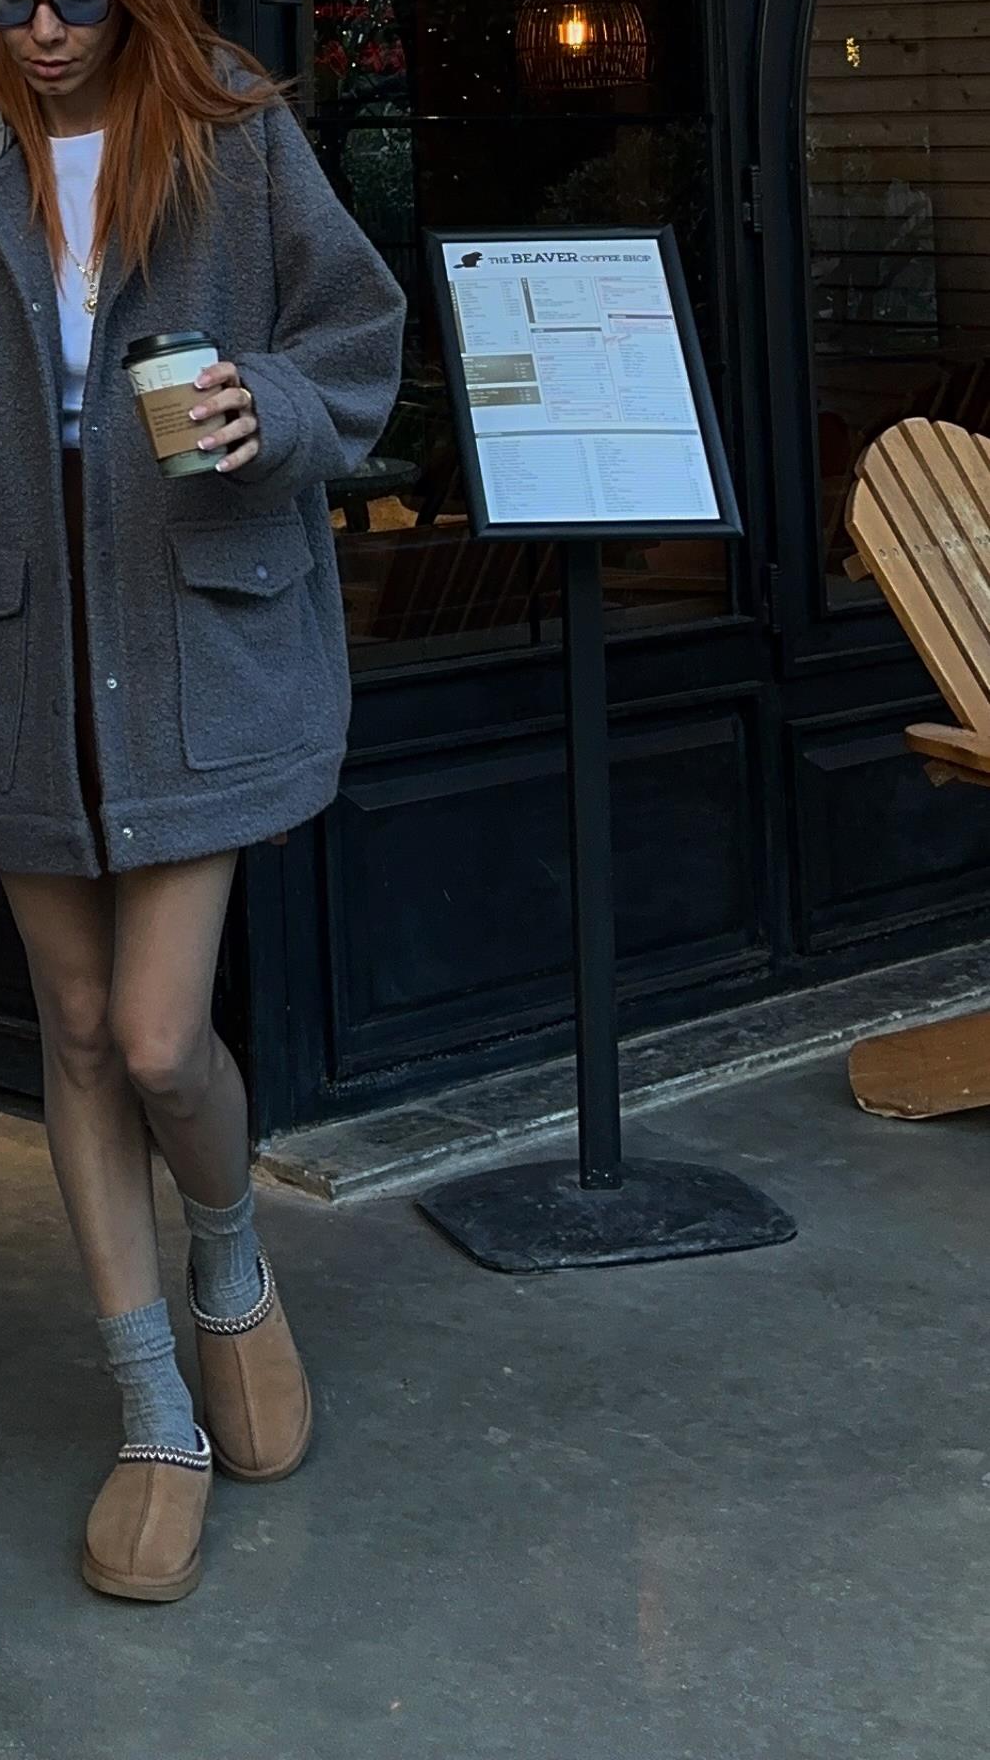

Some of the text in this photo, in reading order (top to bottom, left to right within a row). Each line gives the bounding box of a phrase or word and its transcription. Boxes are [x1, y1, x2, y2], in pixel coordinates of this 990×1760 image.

[488, 252, 652, 265] THE BEAVER COFFEE SHOP
